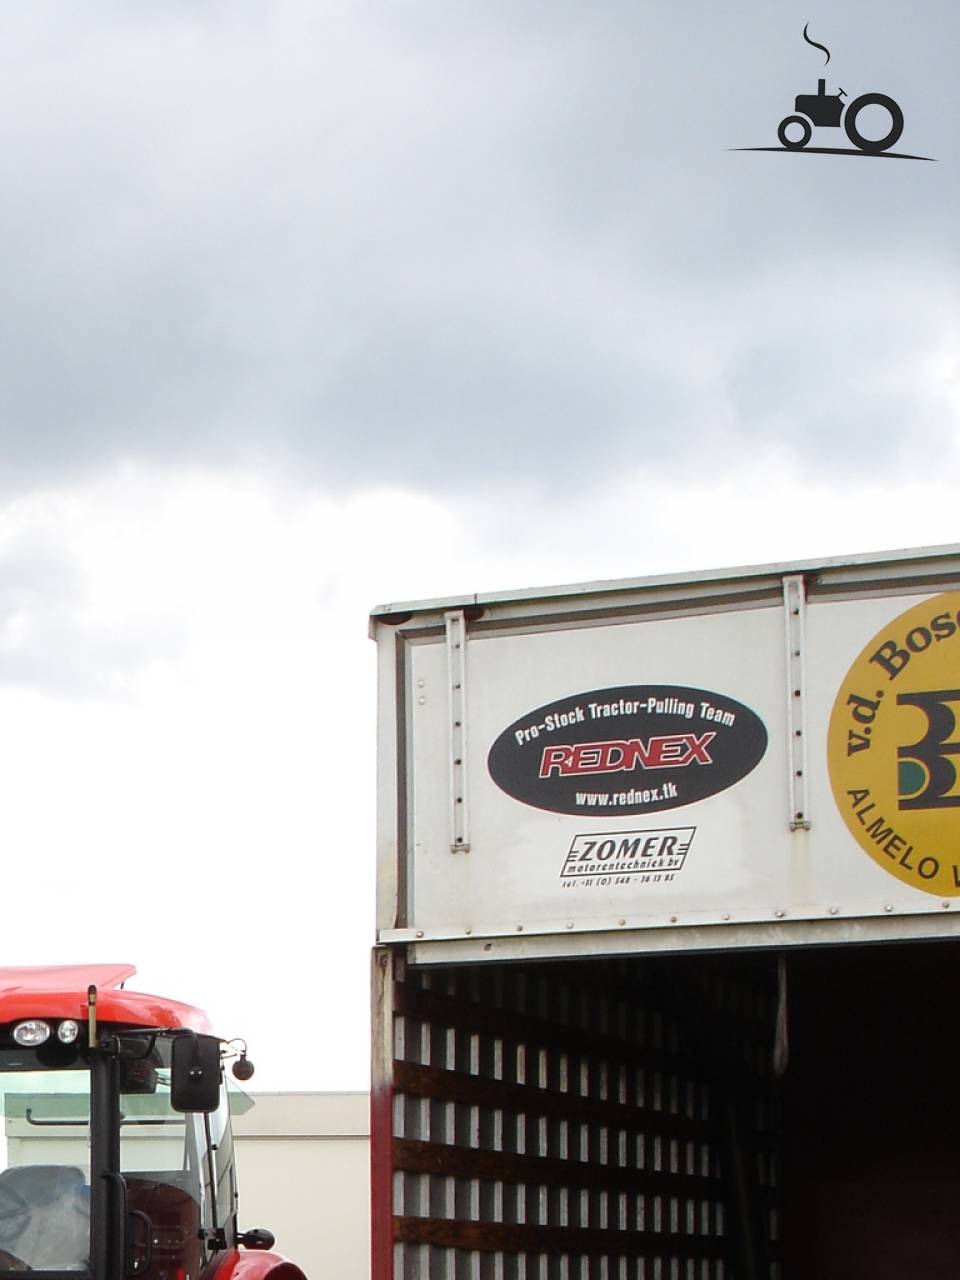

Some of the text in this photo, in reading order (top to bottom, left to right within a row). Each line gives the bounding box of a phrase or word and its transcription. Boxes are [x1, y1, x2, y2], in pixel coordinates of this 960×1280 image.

[846, 608, 960, 757] v.d. Bos
[514, 697, 736, 746] Pro-Stock Tractor-Pulling Team
[539, 732, 717, 778] REDNEX
[575, 782, 678, 806] www.rednex.tk
[578, 836, 678, 862] ZOMER
[846, 788, 939, 880] ALMELO
[567, 859, 664, 873] motorentechniek
